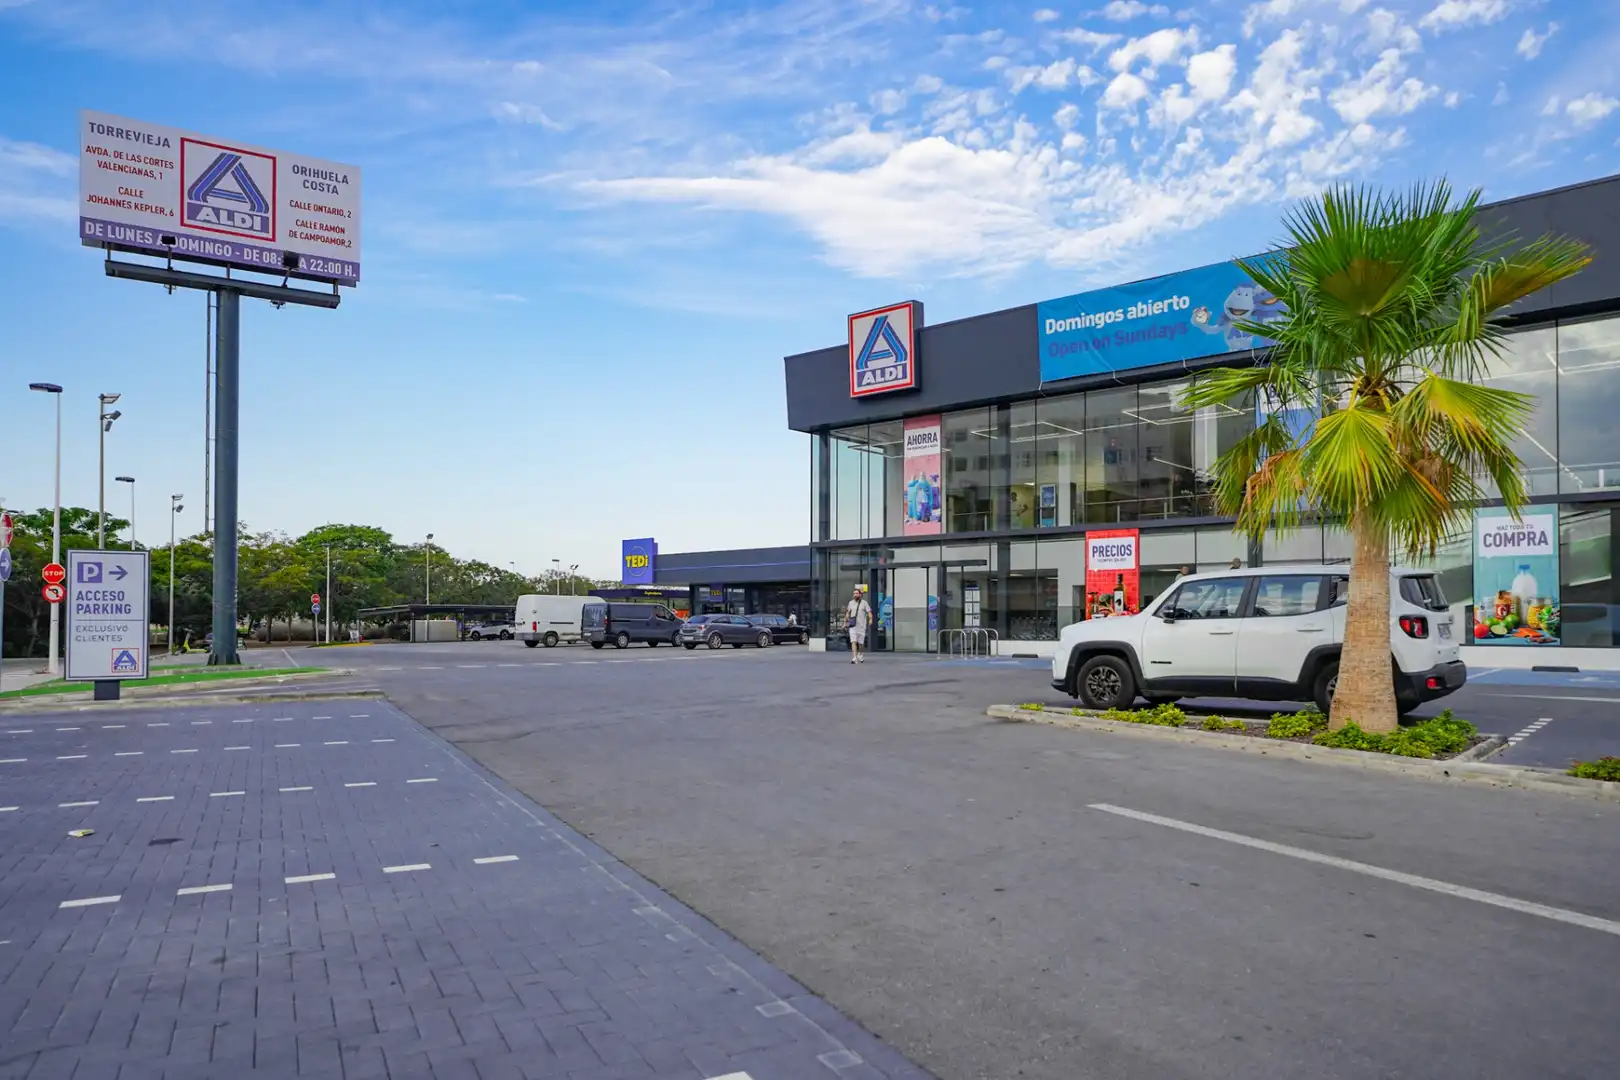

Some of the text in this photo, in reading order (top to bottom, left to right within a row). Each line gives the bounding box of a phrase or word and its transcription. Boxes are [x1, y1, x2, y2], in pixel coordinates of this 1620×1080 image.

[89, 122, 170, 148] TORREVIEJA
[86, 145, 174, 170] AVDA. DE LAS CORTES
[96, 160, 163, 180] VALENCIANAS, 1
[292, 164, 349, 184] ORIHUELA
[118, 186, 144, 198] CALLE
[302, 180, 339, 195] COSTA
[86, 194, 132, 210] JOHANNES
[134, 202, 168, 216] KEPLER,
[290, 200, 352, 218] CALLE ONTARIO, 2
[196, 206, 262, 230] ALDI
[296, 219, 318, 230] CALLE
[288, 230, 298, 238] DE
[85, 221, 104, 236] DE
[108, 225, 153, 244] LUNES
[244, 248, 260, 262] DE
[299, 258, 308, 270] A
[310, 259, 342, 274] 22:00
[344, 264, 356, 277] H.
[1045, 295, 1190, 334] Domingos abierto
[1048, 322, 1188, 358] Open on Sundays
[862, 366, 902, 385] ALDI
[906, 432, 938, 446] AHORRA
[1483, 530, 1548, 548] COMPRA
[1092, 544, 1132, 558] PRECIOS
[626, 554, 648, 568] TEDi
[76, 590, 125, 601] ACCESO
[76, 604, 132, 614] PARKING
[76, 624, 129, 633] EXCLUSIVO
[76, 634, 123, 642] CLIENTES
